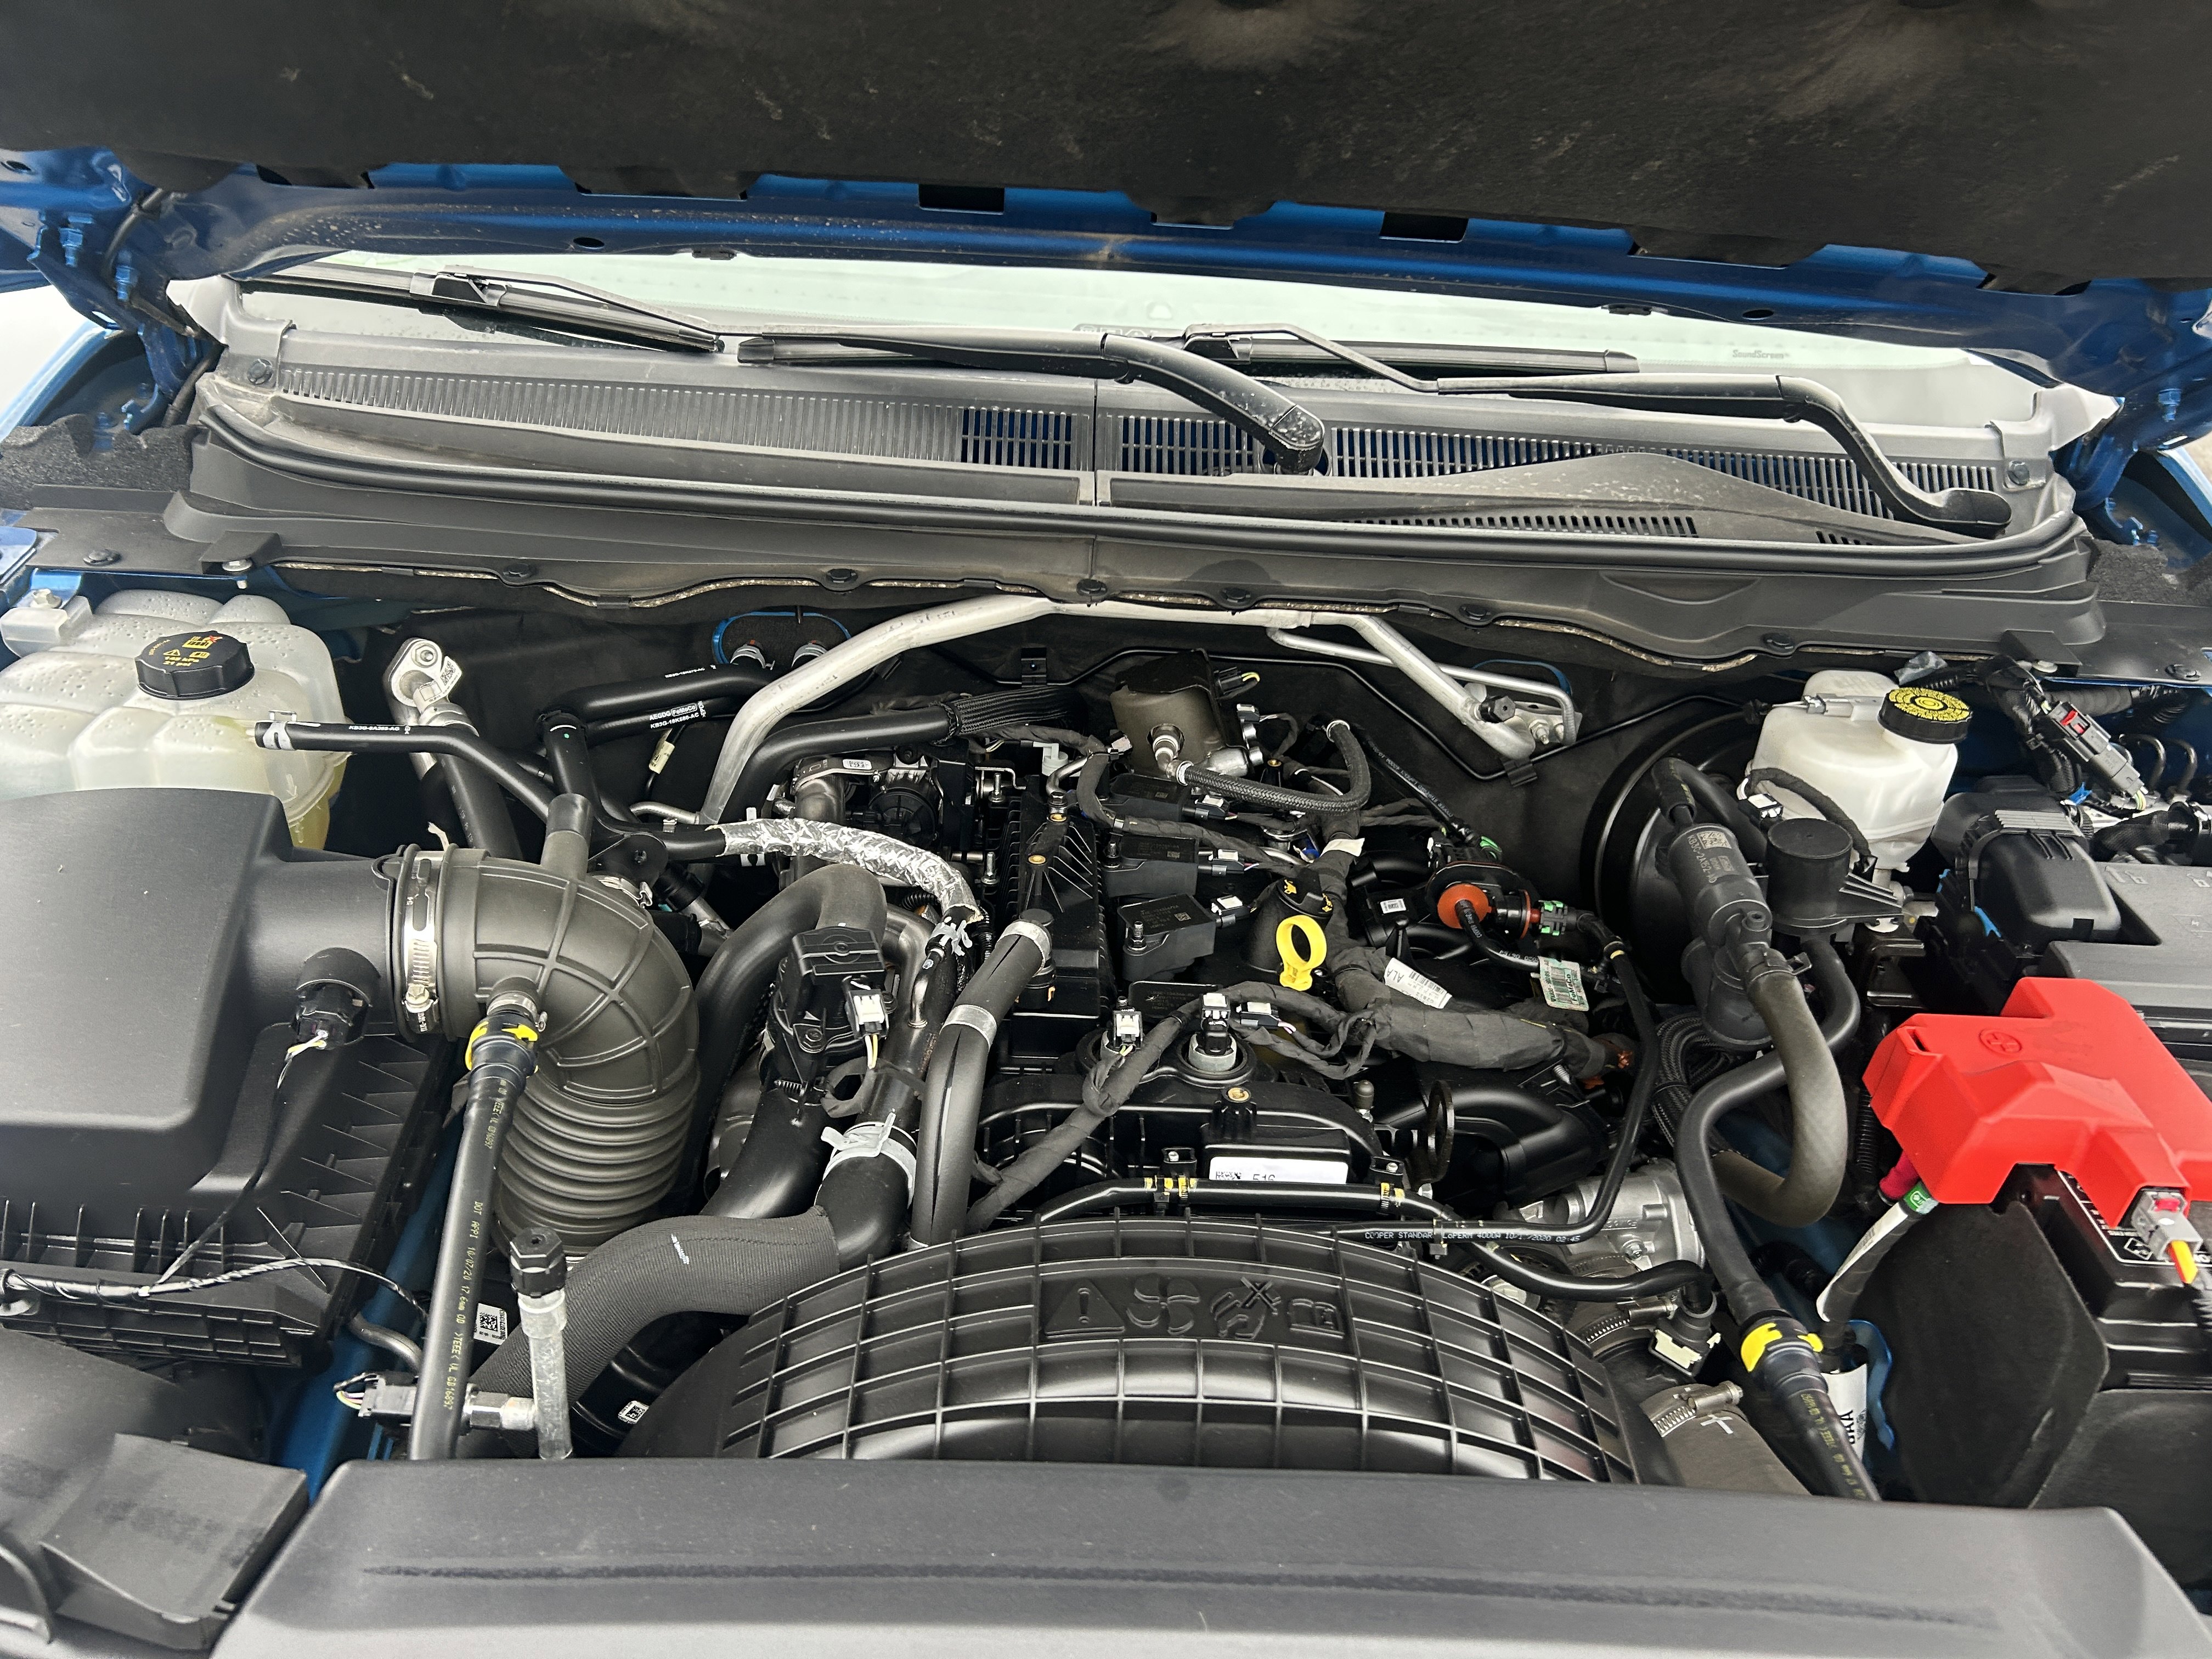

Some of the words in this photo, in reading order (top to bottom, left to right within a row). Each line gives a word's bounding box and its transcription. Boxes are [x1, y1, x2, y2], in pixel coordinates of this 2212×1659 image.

[672, 704, 696, 715] FoMoCo
[1386, 968, 1404, 983] ALA
[1566, 973, 1578, 1002] FoMoCo
[473, 1200, 483, 1215] DOT
[462, 1247, 476, 1280] 10/07/20
